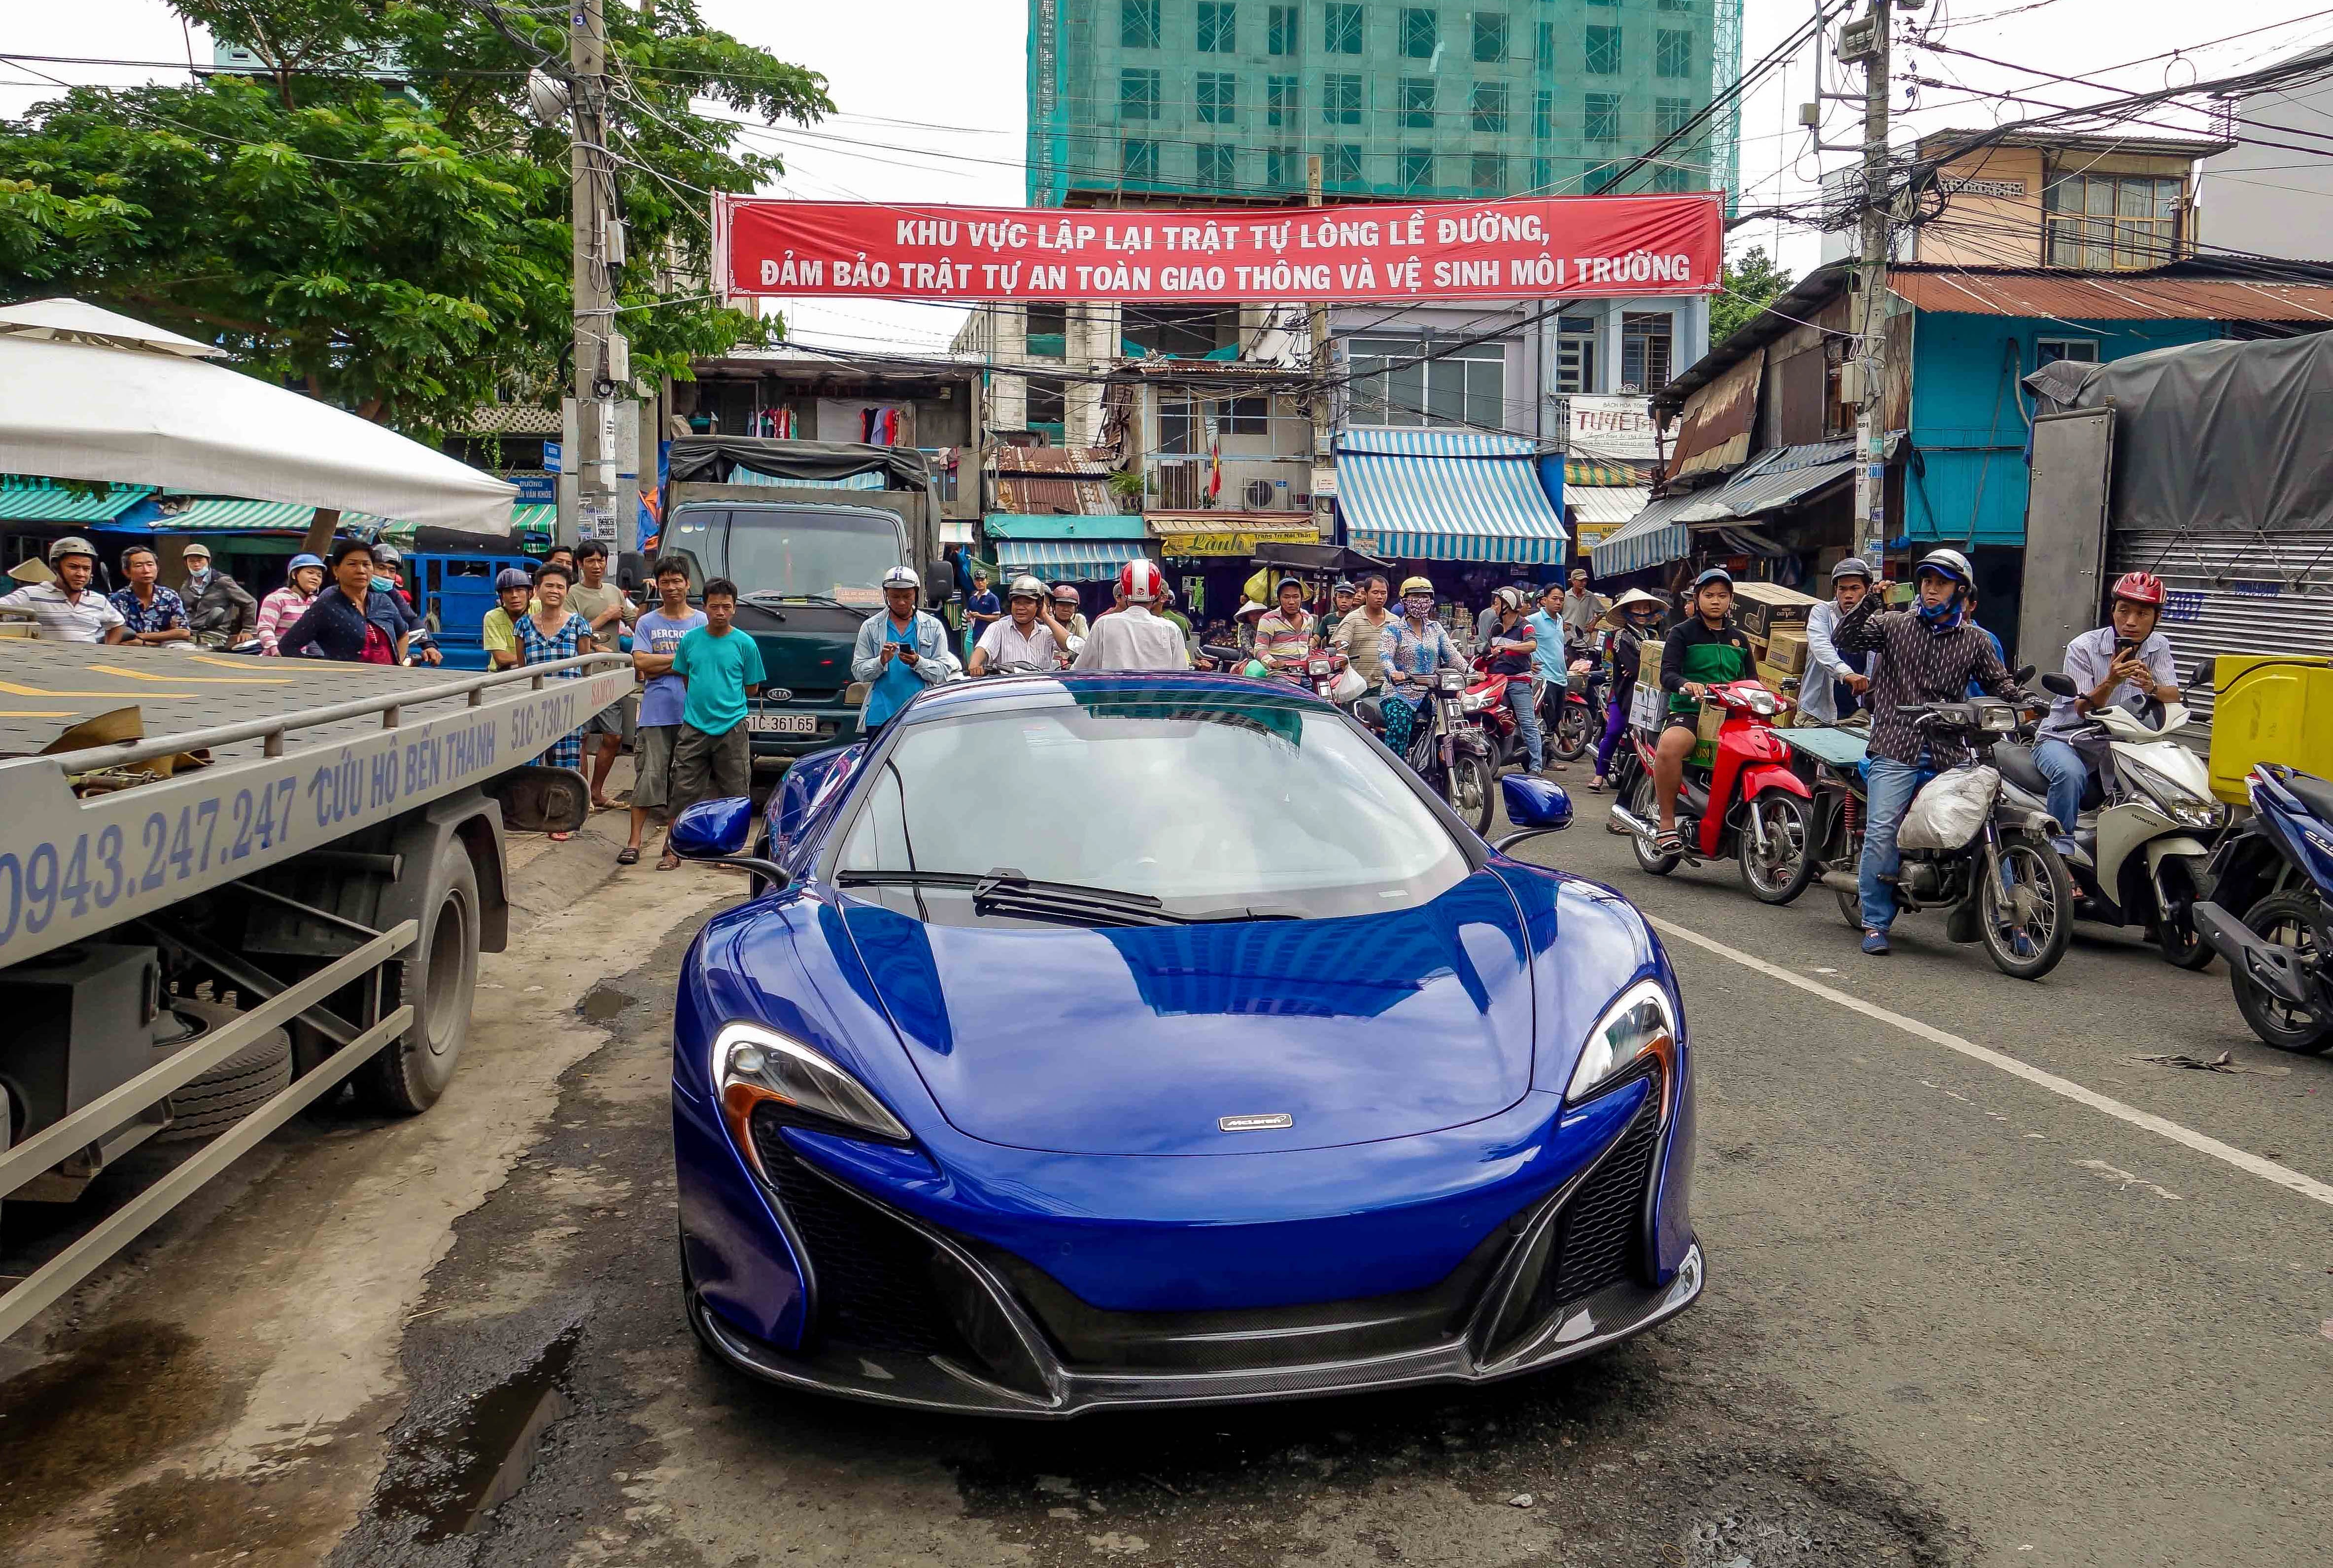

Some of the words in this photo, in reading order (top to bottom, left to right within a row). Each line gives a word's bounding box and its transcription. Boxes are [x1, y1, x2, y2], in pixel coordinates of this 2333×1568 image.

[576, 16, 583, 25] 3
[896, 219, 959, 247] KHU
[967, 218, 1029, 253] VỰC
[1037, 218, 1096, 254] LẬP
[1105, 226, 1153, 256] LẠI
[1161, 220, 1240, 256] TRẬT
[1249, 219, 1292, 255] TỰ
[1300, 216, 1379, 248] LÒNG
[1389, 208, 1426, 246] LỀ
[1437, 209, 1550, 246] ĐƯỜNG,
[759, 249, 823, 286] ĐẢM
[832, 251, 891, 288] BẢO
[898, 256, 973, 295] TRẬT
[981, 260, 1022, 295] TỰ
[1028, 265, 1067, 290] AN
[1075, 260, 1151, 291] TOÀN
[1160, 266, 1226, 292] GIAO
[1233, 259, 1331, 291] THÔNG
[1338, 257, 1377, 290] VÀ
[1385, 255, 1422, 293] VỆ
[1433, 260, 1500, 288] SINH
[1510, 251, 1565, 286] MÔI
[1573, 248, 1690, 285] TRƯỜNG
[651, 629, 690, 640] BERCRO
[405, 722, 442, 796] BẾN
[446, 713, 497, 781] THÀNH
[2130, 813, 2158, 827] HONDA
[1227, 1117, 1282, 1126] McLaren
